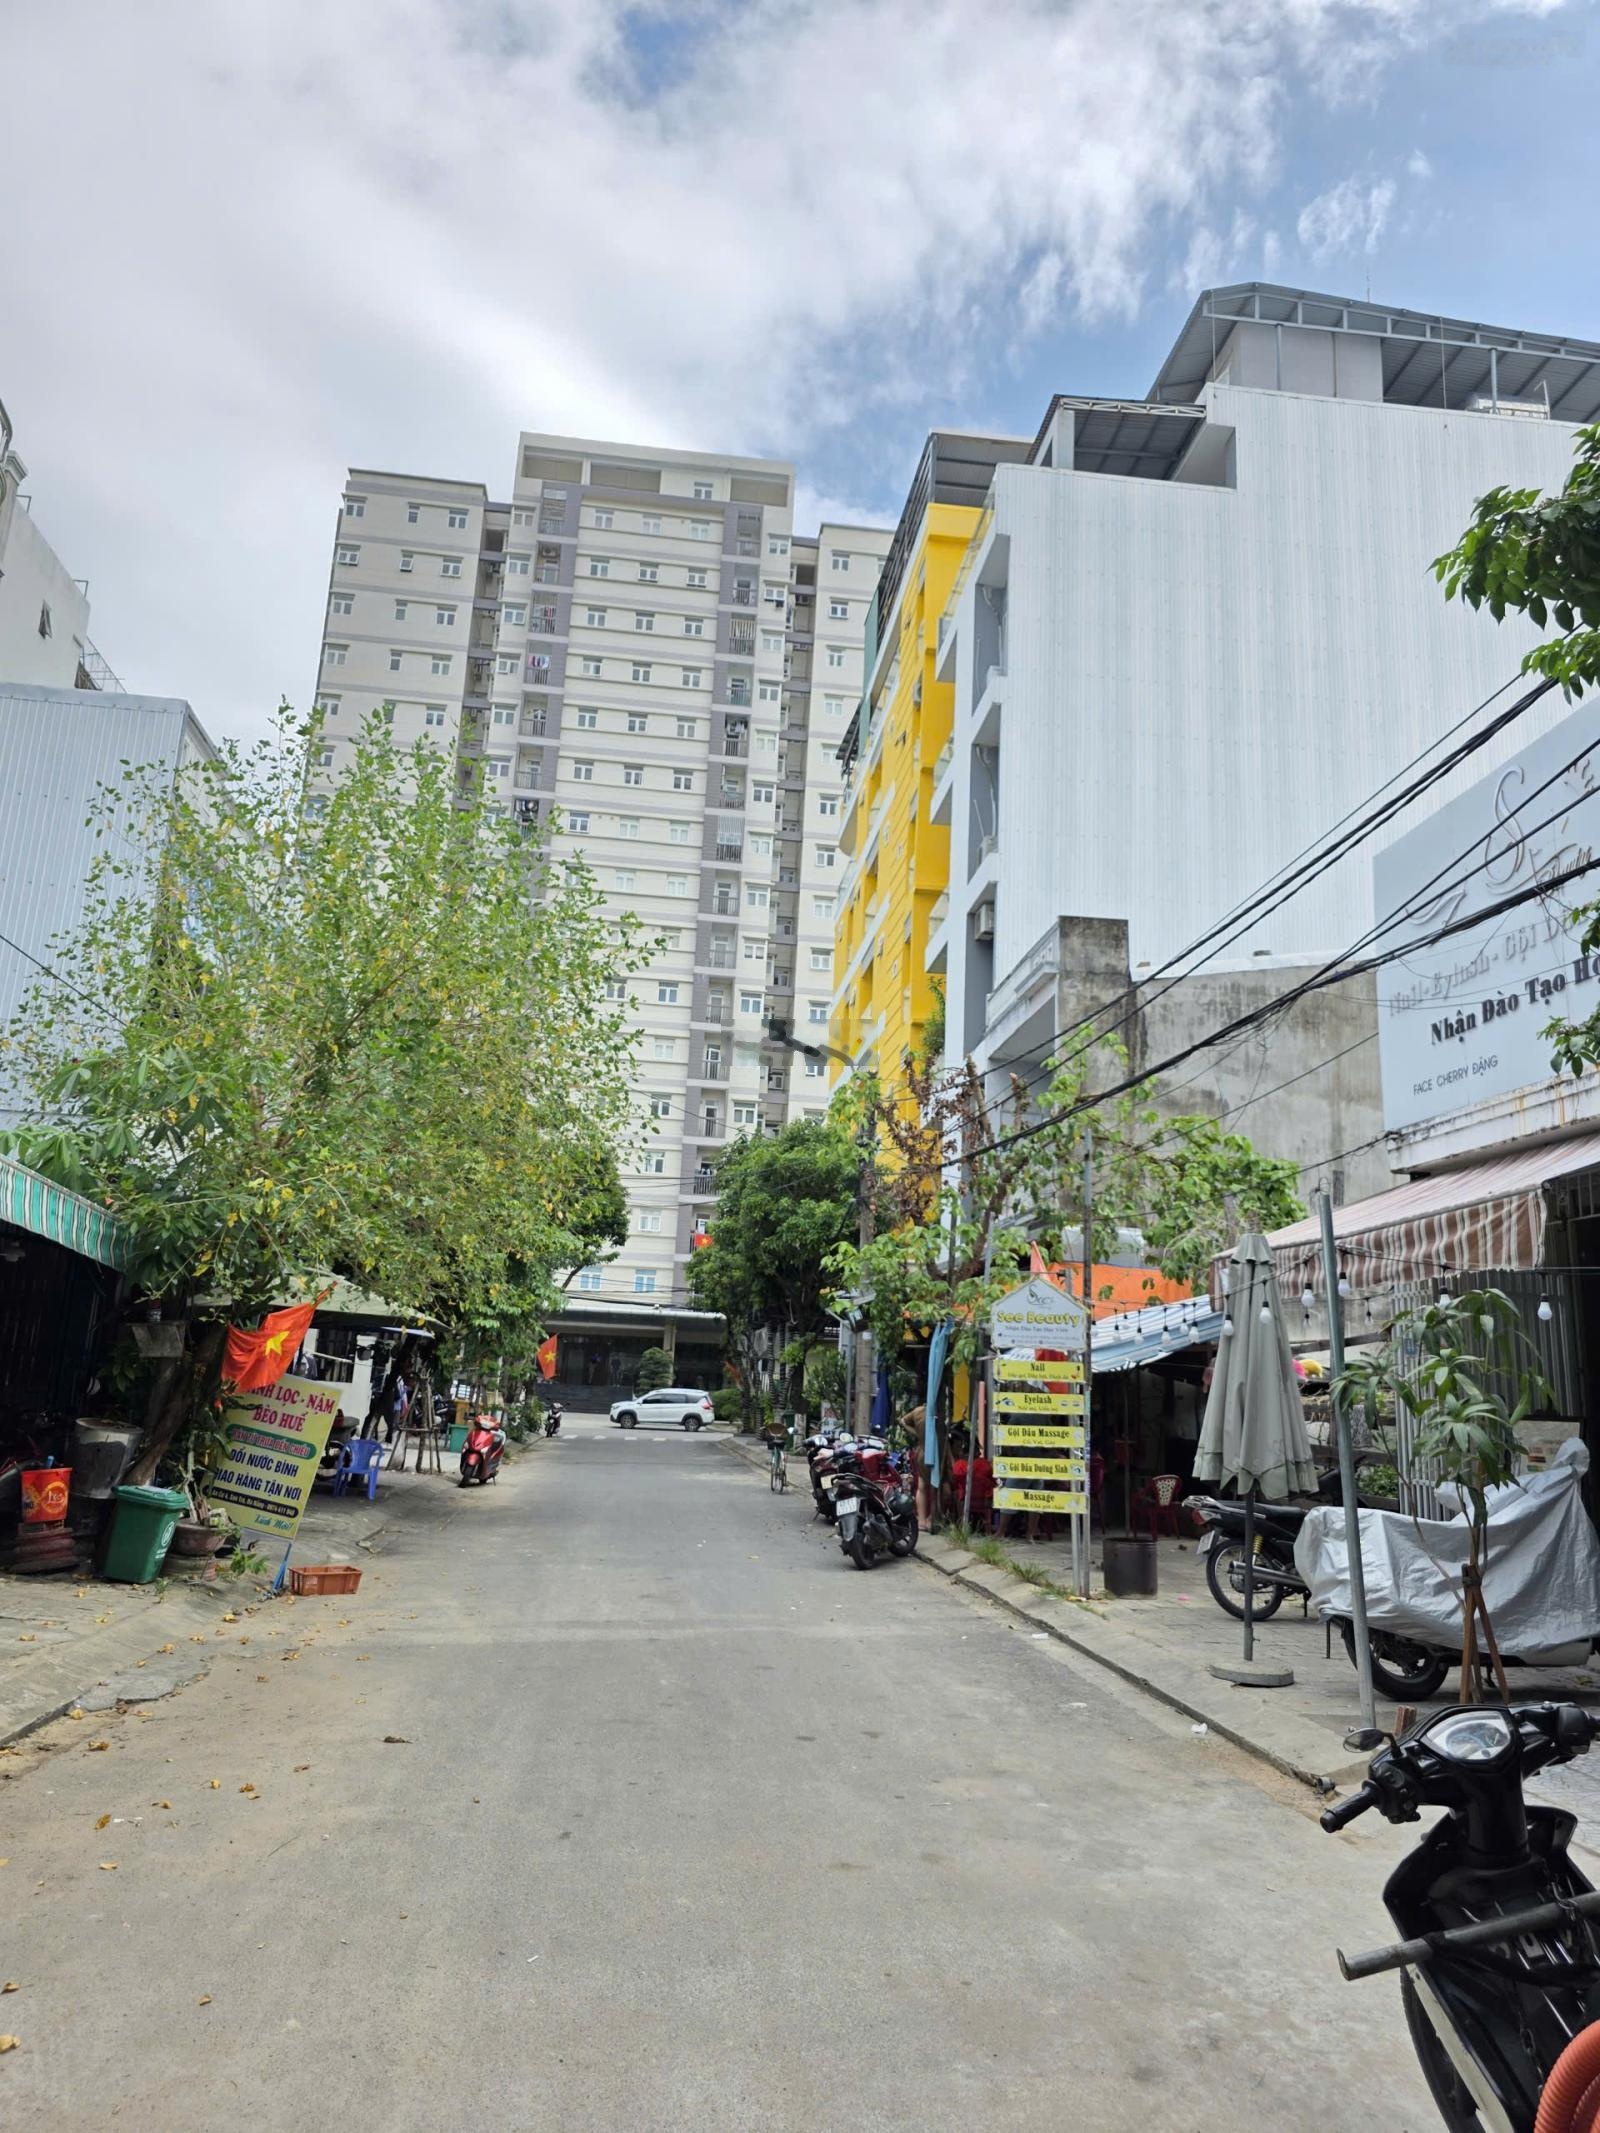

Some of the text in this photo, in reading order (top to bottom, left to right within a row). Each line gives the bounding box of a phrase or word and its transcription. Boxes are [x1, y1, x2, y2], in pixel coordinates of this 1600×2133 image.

[1430, 1009, 1477, 1046] Nhận
[1481, 990, 1520, 1025] Đào
[1524, 973, 1566, 1005] Tạo
[1413, 1078, 1433, 1096] FACE
[1436, 1065, 1469, 1088] CHERRY
[997, 1311, 1080, 1328] See Beauty
[1030, 1362, 1045, 1372] Nail
[276, 1385, 300, 1407] LỌC
[306, 1392, 336, 1415] NẬM
[1024, 1394, 1052, 1405] Eyelash
[253, 1404, 309, 1432] BÈO HUẾ
[1039, 1428, 1070, 1439] Massage
[247, 1453, 274, 1471] NƯỚC
[274, 1459, 299, 1478] BÌNH
[1055, 1464, 1068, 1474] Sinh
[235, 1472, 263, 1491] HÀNG
[263, 1479, 284, 1497] TẬN
[284, 1485, 303, 1501] NƠI
[1024, 1491, 1055, 1503] Massage
